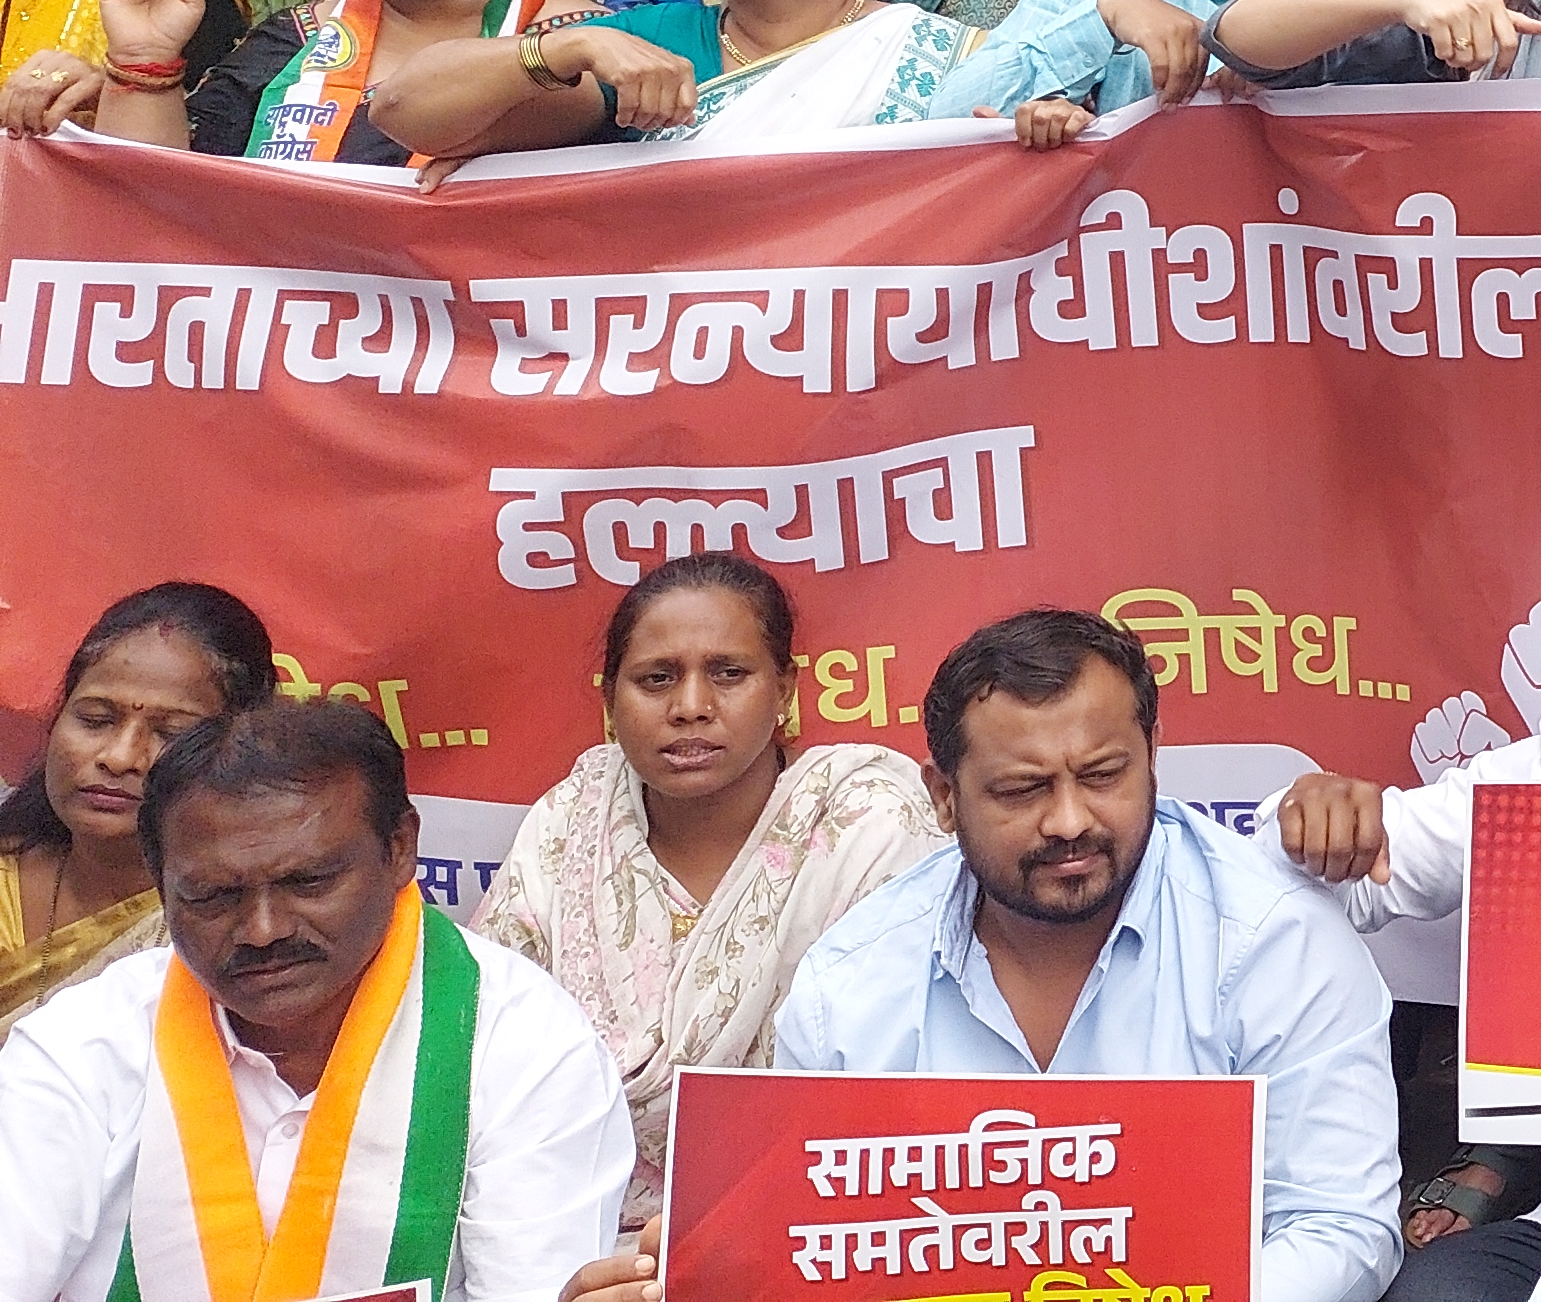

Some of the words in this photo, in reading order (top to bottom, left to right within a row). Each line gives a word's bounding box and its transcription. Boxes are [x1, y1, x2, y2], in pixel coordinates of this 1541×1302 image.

[488, 425, 1035, 589] हल्ल्याचा
[804, 1109, 1122, 1198] सामाजिक
[788, 1189, 1133, 1281] समतेवरील
